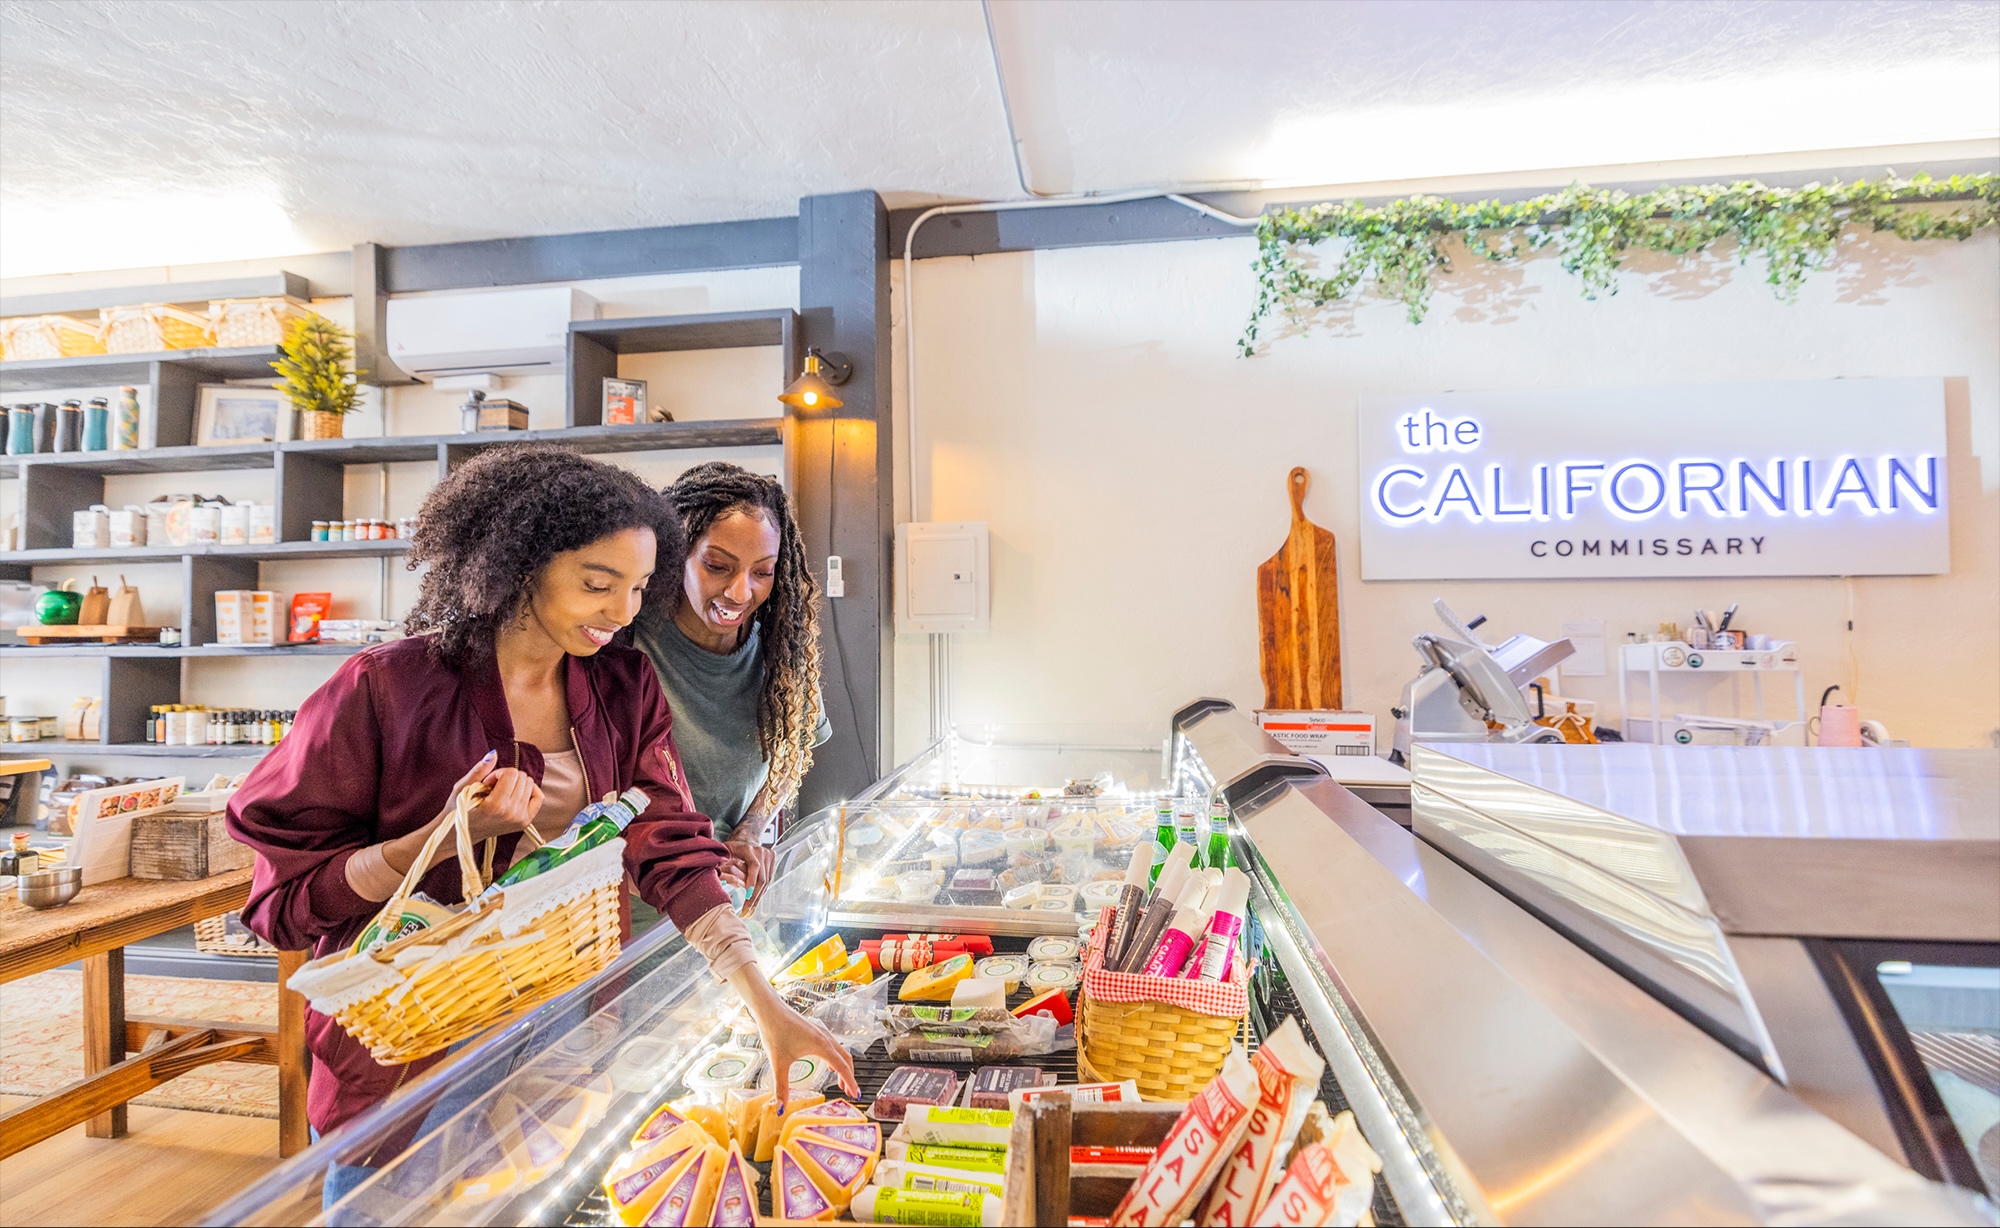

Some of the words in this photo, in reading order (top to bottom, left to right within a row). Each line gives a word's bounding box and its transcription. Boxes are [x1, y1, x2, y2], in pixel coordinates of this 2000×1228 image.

[1403, 411, 1479, 447] the
[1378, 457, 1939, 518] CALIFORNIAN
[1530, 536, 1765, 557] COMMISSARY
[1123, 1128, 1204, 1227] SALA
[1208, 1109, 1269, 1227] SALA
